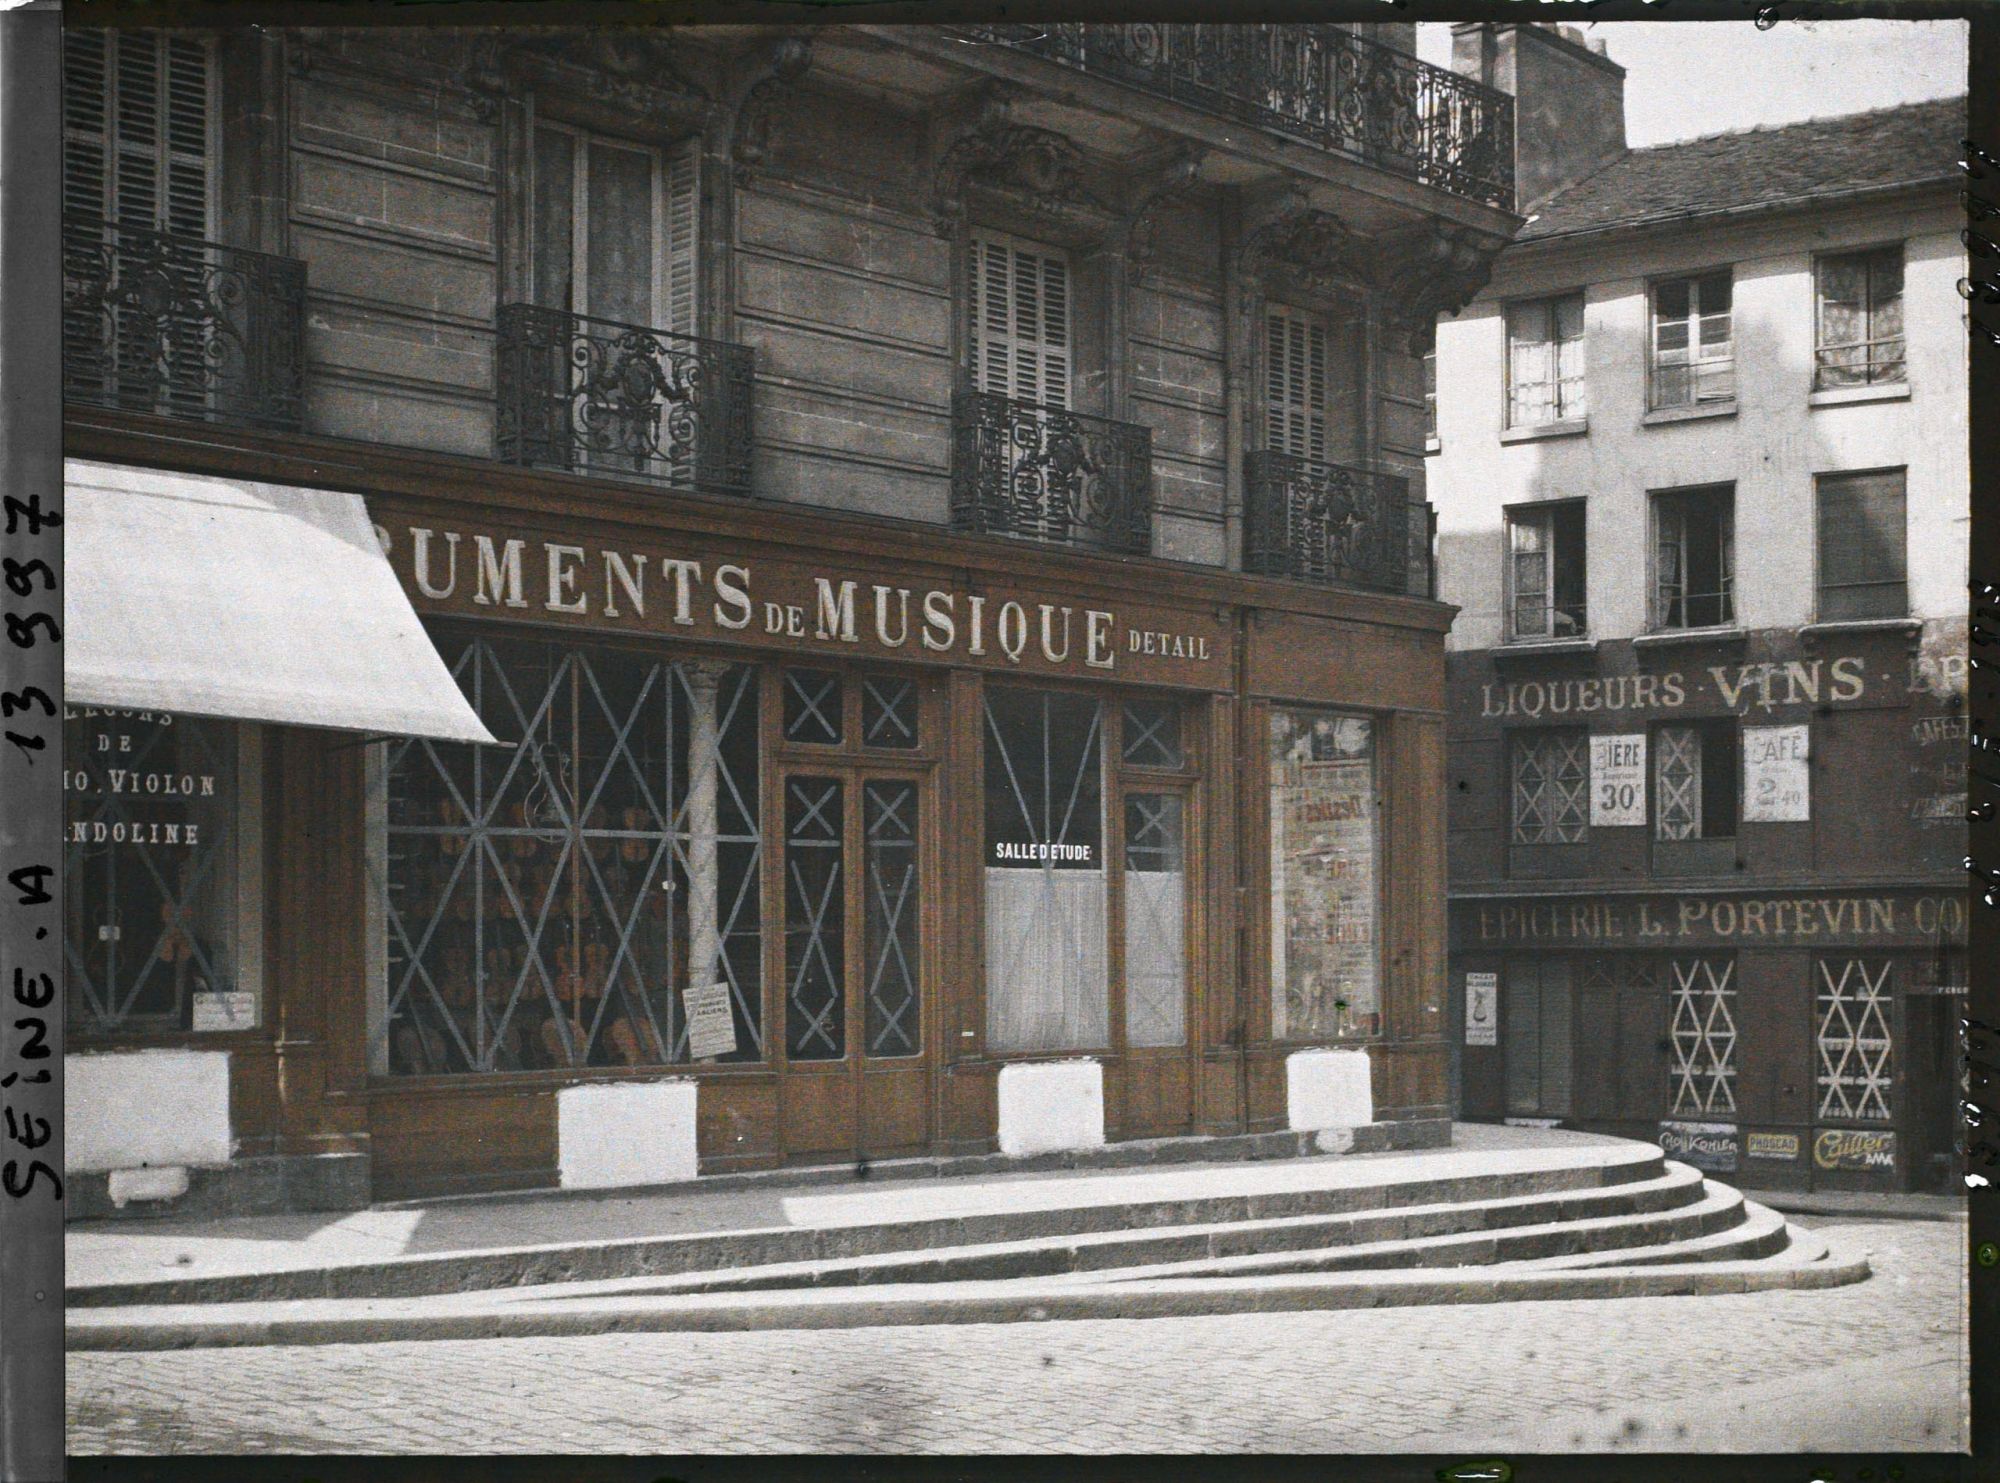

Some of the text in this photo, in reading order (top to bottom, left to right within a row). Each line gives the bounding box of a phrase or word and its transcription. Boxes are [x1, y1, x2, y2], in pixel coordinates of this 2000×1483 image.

[372, 522, 1211, 670] UMENTS DE MUSIQUE DETAIL
[1481, 672, 1685, 717] LIQUEURS
[1707, 656, 1866, 710] VINS
[97, 734, 132, 753] DE
[108, 769, 216, 797] VIOLON
[64, 822, 200, 845] NDOLINE
[996, 842, 1038, 860] SALLE
[1638, 902, 1670, 937] L.
[1678, 897, 1896, 938] PORTEVIN
